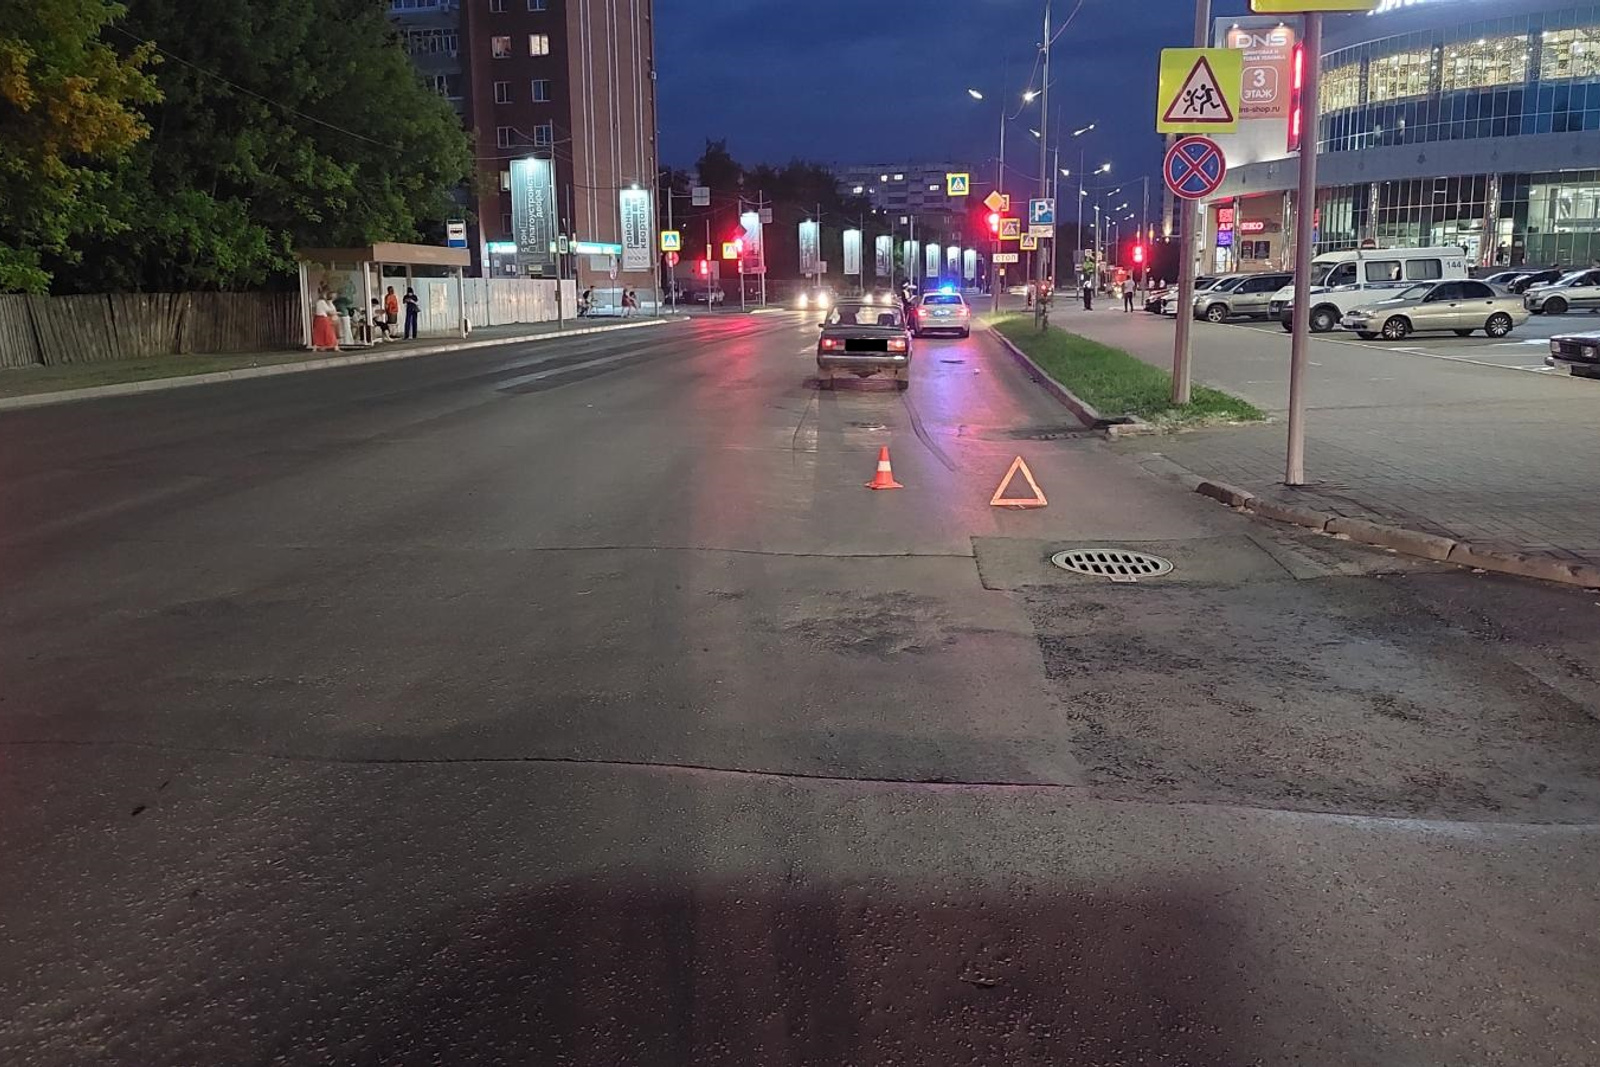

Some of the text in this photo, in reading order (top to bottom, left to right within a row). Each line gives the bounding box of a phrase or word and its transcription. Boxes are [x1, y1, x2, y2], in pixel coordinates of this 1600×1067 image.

[1236, 33, 1287, 48] DNS
[1253, 69, 1266, 87] 3
[1244, 89, 1273, 99] ЭТАЖ
[535, 189, 544, 218] двора
[639, 197, 647, 249] кварталы
